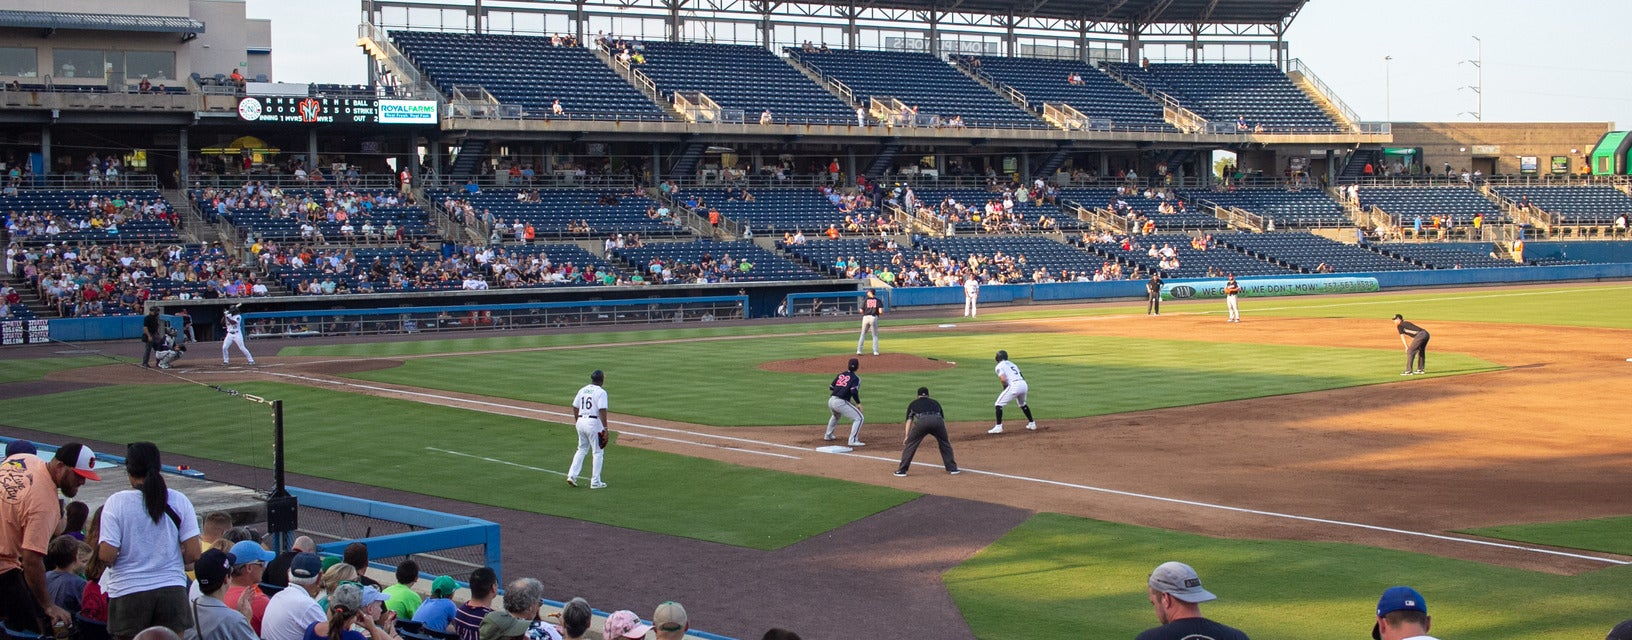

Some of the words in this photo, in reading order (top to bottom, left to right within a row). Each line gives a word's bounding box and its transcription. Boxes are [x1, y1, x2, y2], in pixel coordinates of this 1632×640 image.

[1202, 287, 1216, 296] WE
[1251, 285, 1265, 294] WE
[1267, 284, 1292, 293] DON'T
[835, 374, 851, 387] 22
[581, 396, 593, 410] 16
